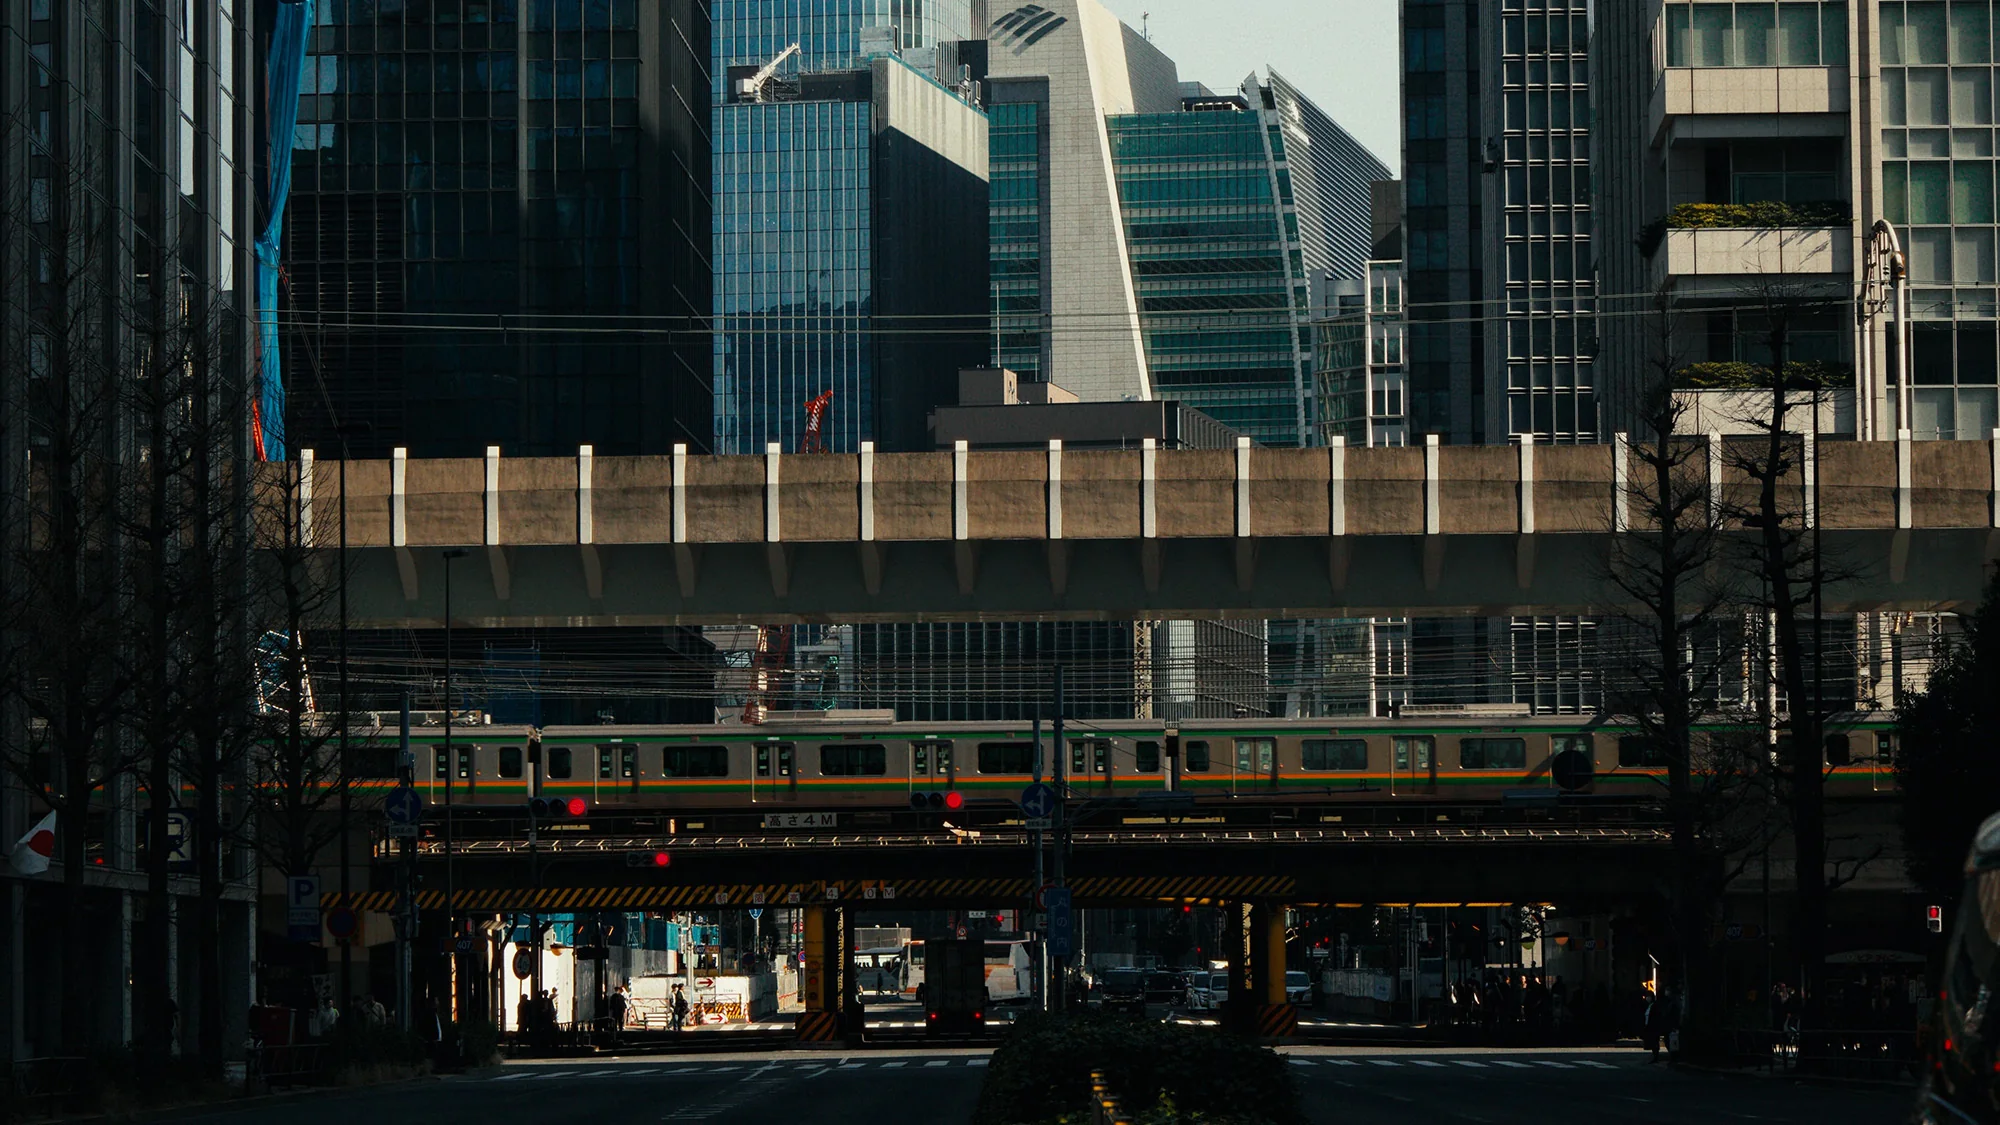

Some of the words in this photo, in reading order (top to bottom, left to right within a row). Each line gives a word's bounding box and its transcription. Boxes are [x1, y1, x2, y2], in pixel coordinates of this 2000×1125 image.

[294, 879, 314, 904] P
[1057, 897, 1068, 948] 丸の内
[457, 940, 471, 950] 407
